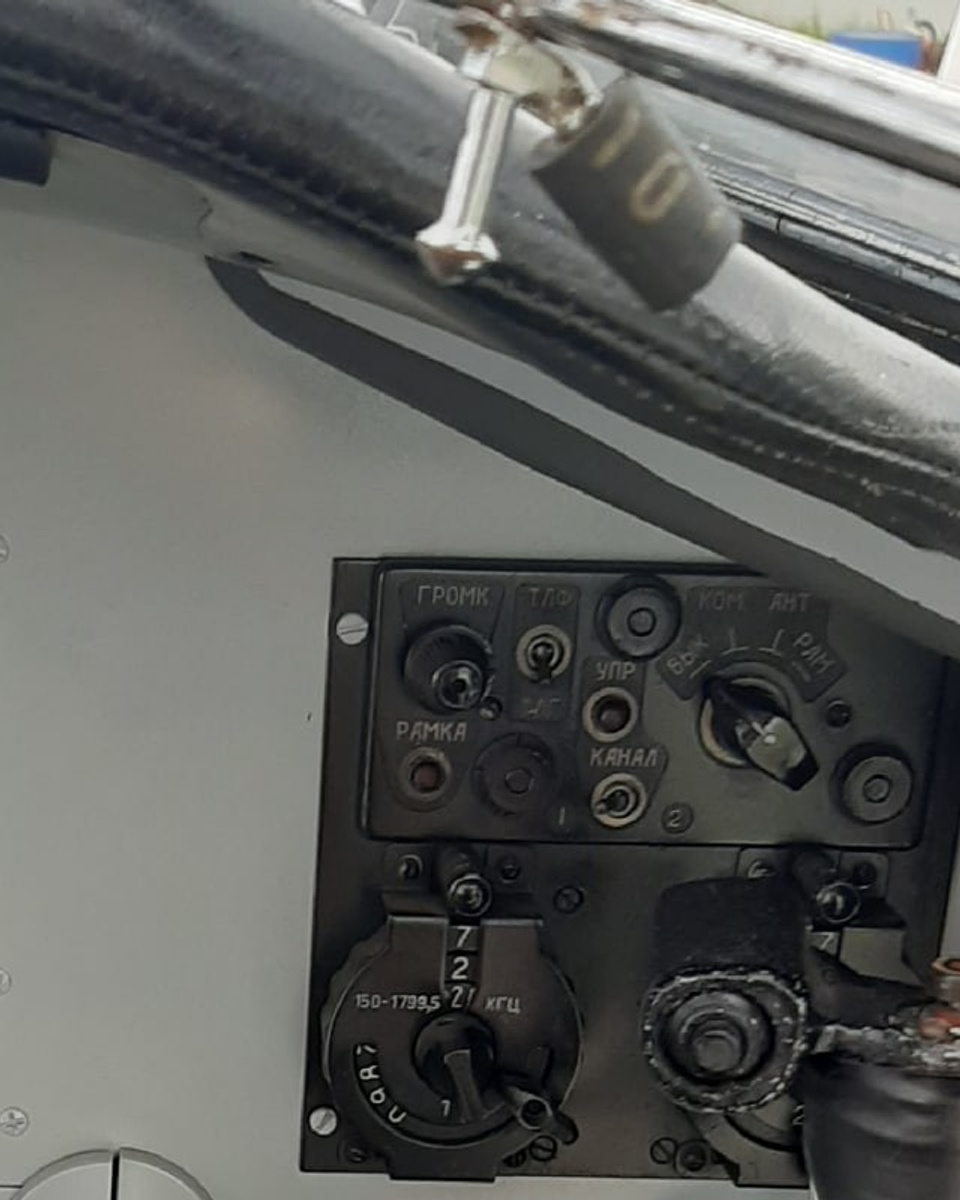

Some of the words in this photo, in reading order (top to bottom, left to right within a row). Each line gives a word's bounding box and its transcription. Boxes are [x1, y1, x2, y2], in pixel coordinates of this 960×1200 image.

[416, 585, 490, 607] ГРОМК
[596, 662, 637, 681] УПР
[395, 720, 468, 743] РАМКА
[590, 747, 658, 768] КАНАЛ
[668, 809, 682, 828] 2
[456, 925, 472, 948] 7
[451, 956, 469, 980] 2
